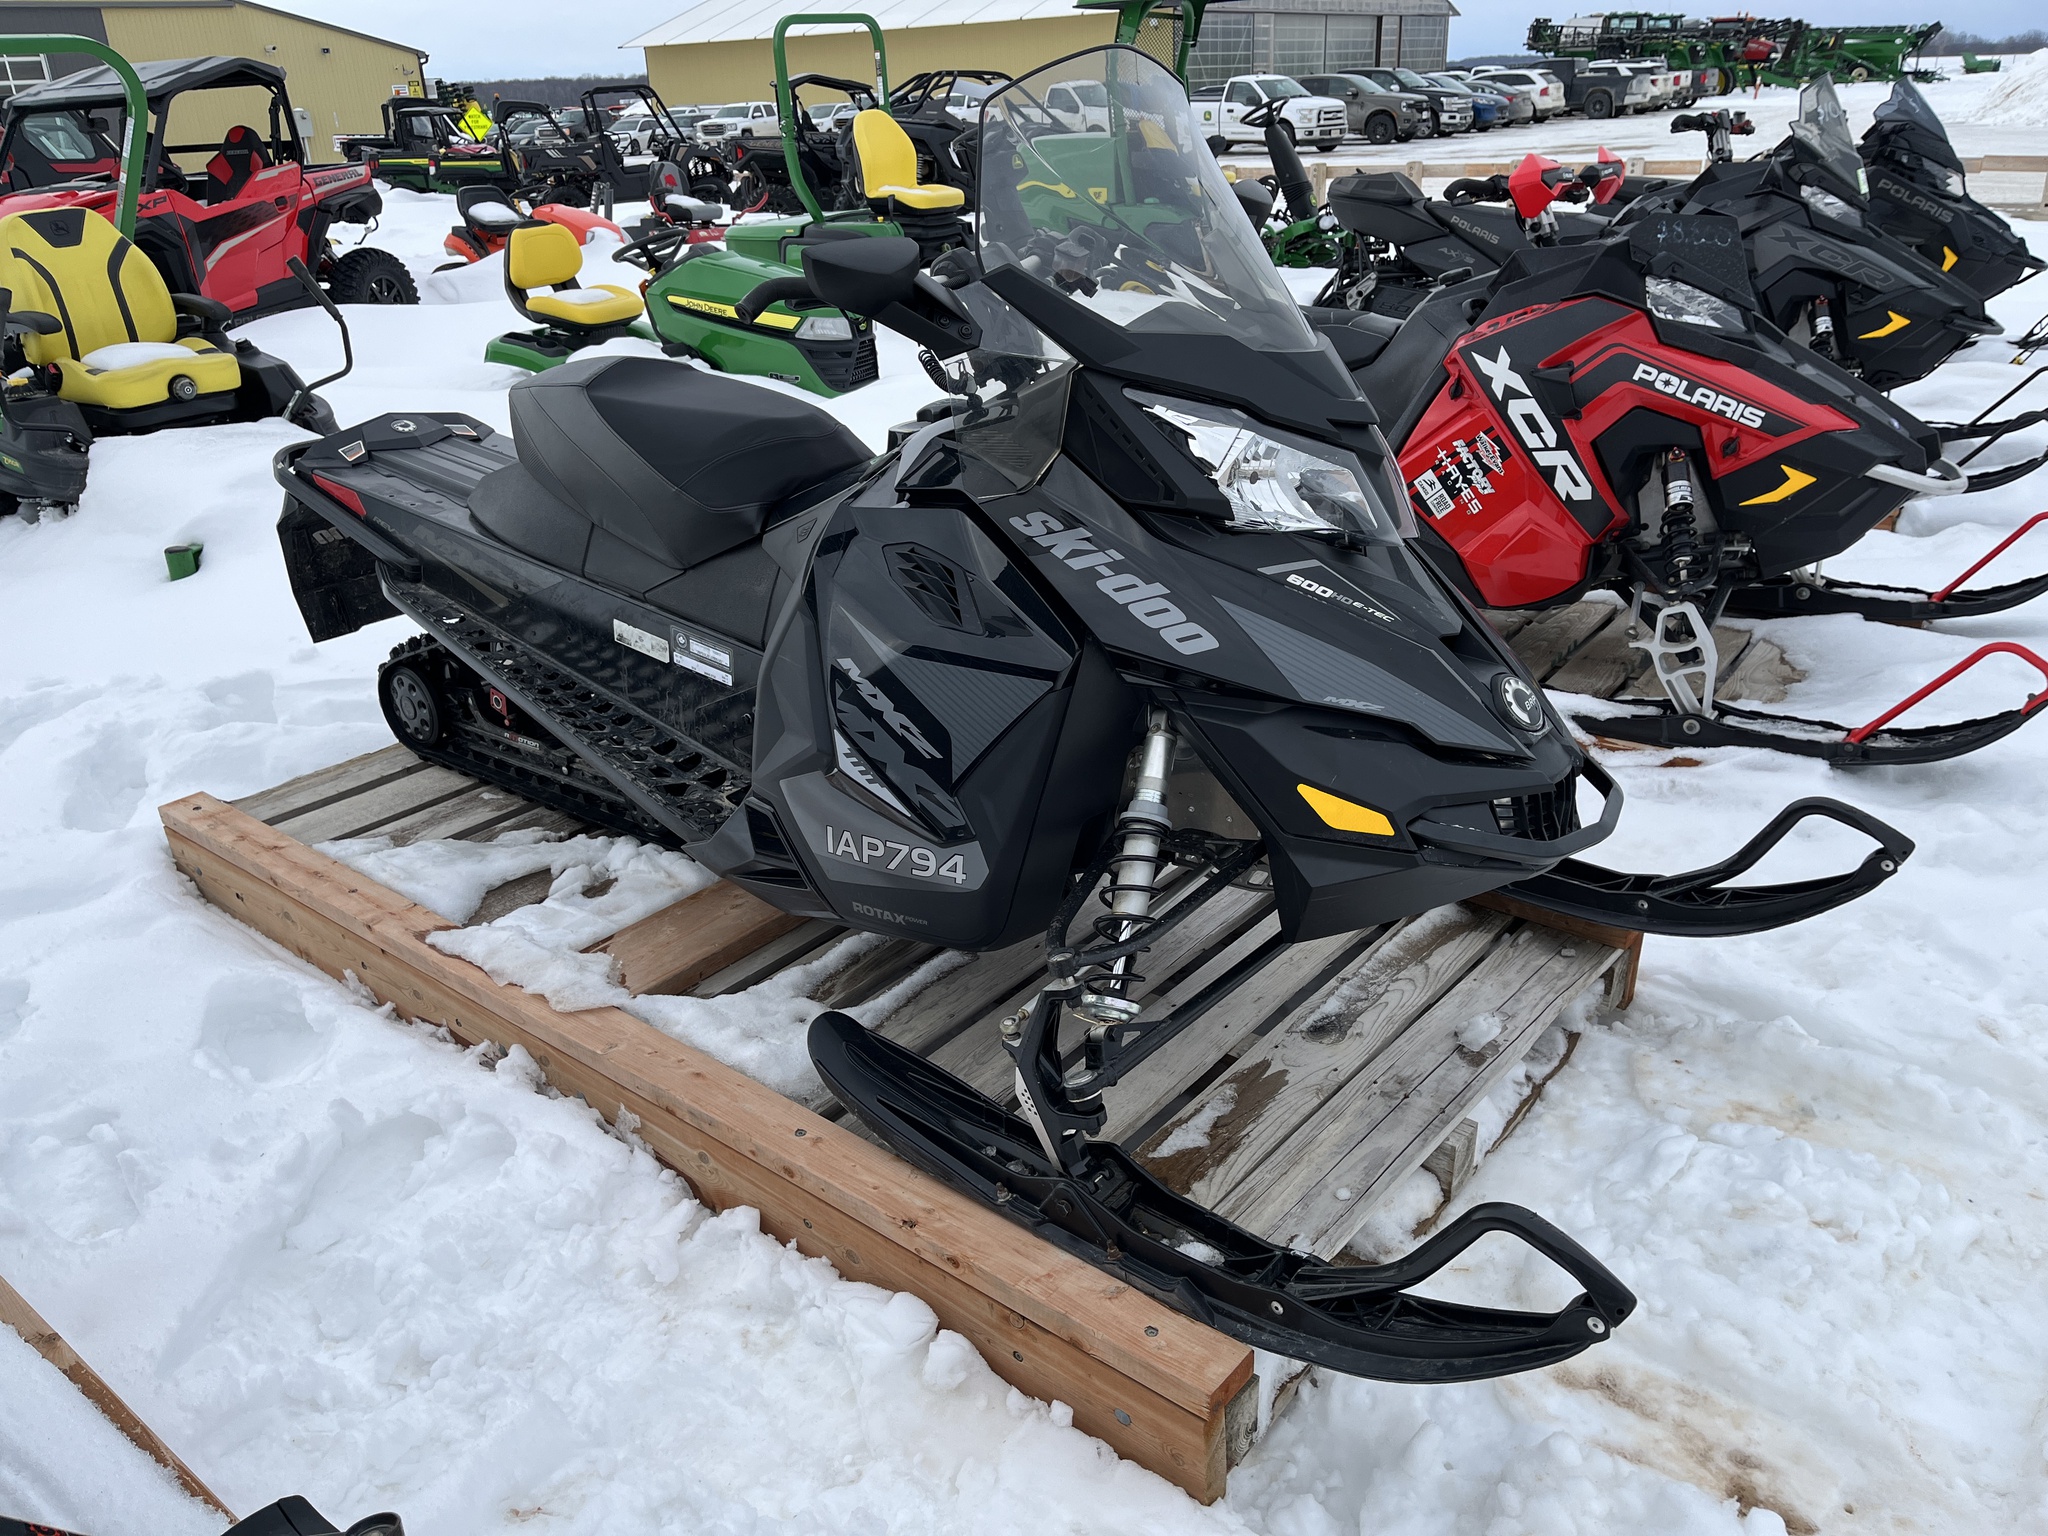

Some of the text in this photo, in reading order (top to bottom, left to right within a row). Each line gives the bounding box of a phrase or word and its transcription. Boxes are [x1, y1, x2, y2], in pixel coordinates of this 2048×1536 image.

[313, 169, 364, 187] GENERAL
[136, 196, 168, 214] XP
[1877, 178, 1955, 223] POLARIS
[1450, 215, 1500, 245] POLARIS
[1763, 226, 1896, 289] XCR
[685, 299, 728, 317] JOHN DEERE
[1632, 362, 1766, 429] POLARIS
[1471, 344, 1593, 502] XCR
[1436, 446, 1483, 515] HAYES
[1452, 439, 1496, 494] FACTORY
[1352, 601, 1395, 623] E-TEC
[836, 658, 943, 759] MXZ
[1524, 695, 1536, 711] BRP
[852, 902, 928, 926] ROTAX POWER
